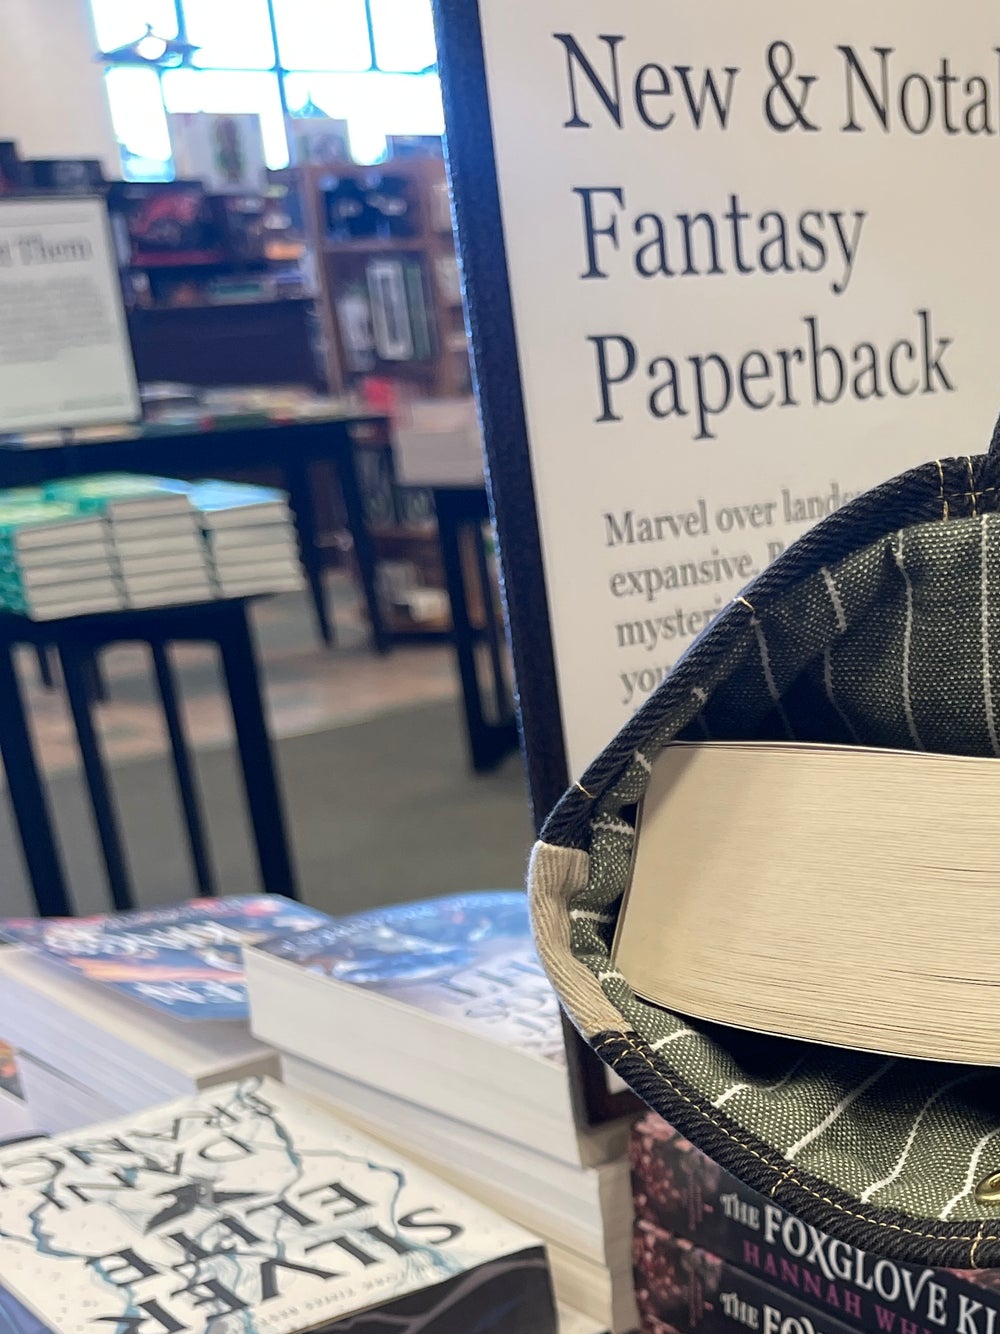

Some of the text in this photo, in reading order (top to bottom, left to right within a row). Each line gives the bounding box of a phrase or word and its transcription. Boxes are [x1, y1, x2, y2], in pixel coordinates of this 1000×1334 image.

[553, 32, 741, 131] New
[763, 39, 822, 134] &
[572, 185, 868, 295] Fantasy
[586, 308, 957, 441] Paperback
[604, 498, 709, 547] Marvel
[715, 500, 778, 533] over
[609, 549, 760, 603] expansive.
[40, 1131, 255, 1211] DANI
[82, 1181, 371, 1291] ELITE
[719, 1191, 761, 1232] THE
[763, 1203, 948, 1327] FOXGLOVE
[741, 1238, 862, 1321] HANNAH
[719, 1291, 760, 1331] THE
